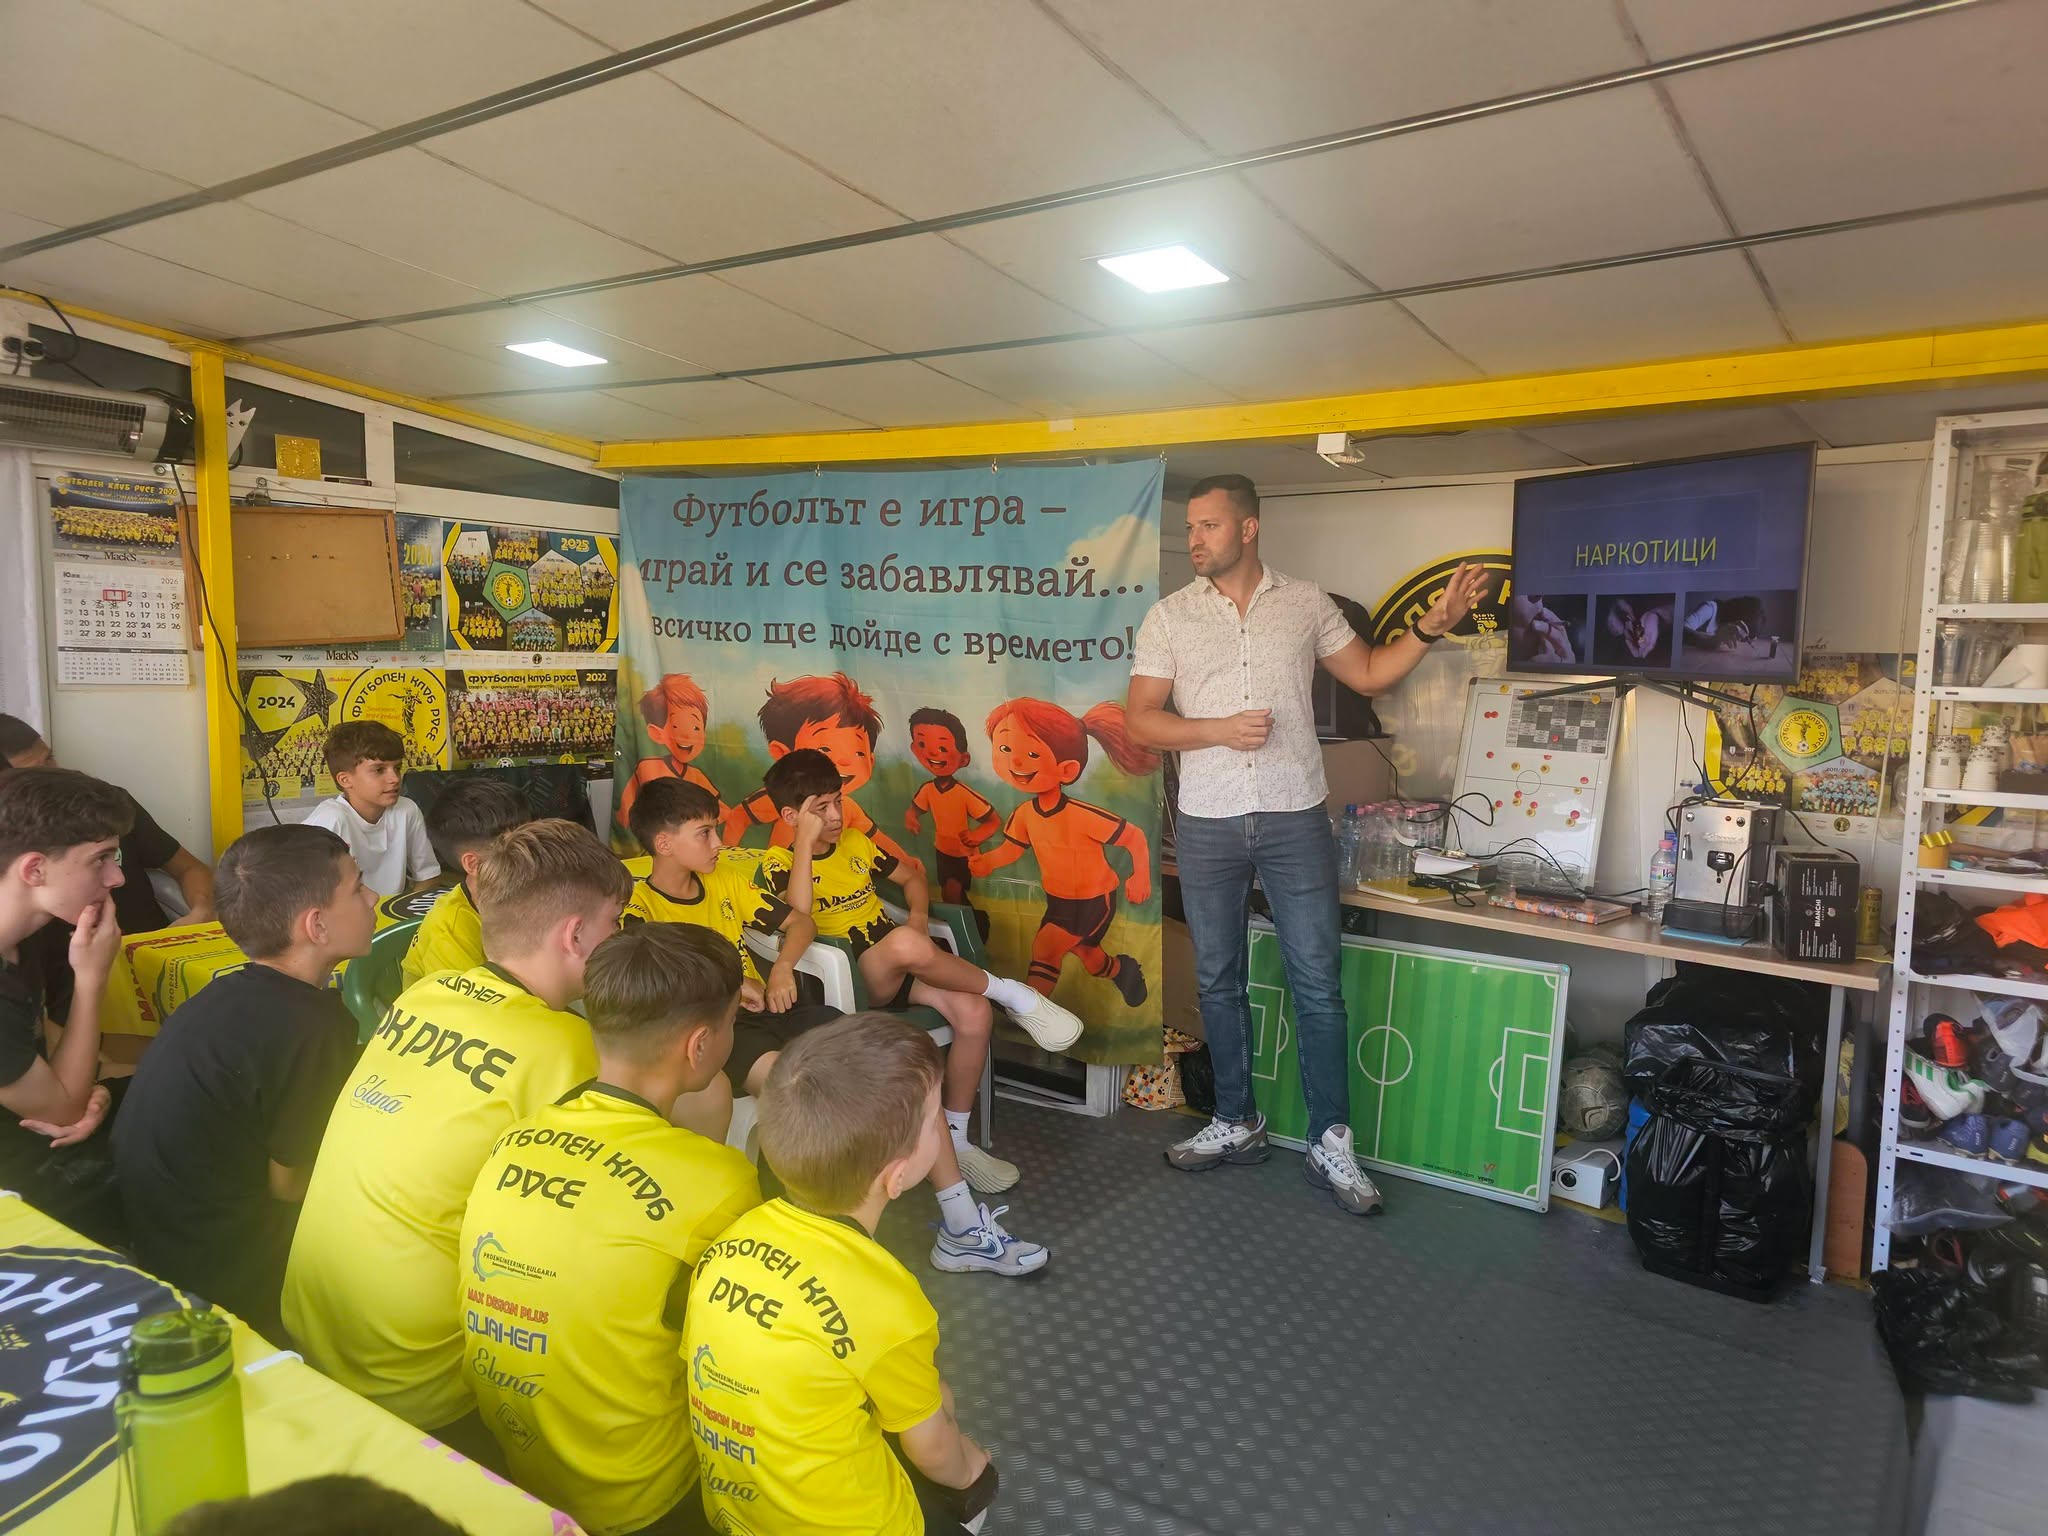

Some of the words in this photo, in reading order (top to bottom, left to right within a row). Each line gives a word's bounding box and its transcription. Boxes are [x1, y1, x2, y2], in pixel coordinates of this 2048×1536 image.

[134, 485, 155, 493] РУСЕ
[673, 490, 866, 537] Футболът
[879, 499, 902, 526] е
[919, 494, 1026, 536] игра
[560, 537, 590, 552] 2025
[1575, 536, 1717, 567] НАРКОТИЦИ
[746, 562, 770, 586] и
[783, 561, 828, 587] се
[840, 553, 1144, 599] забавлявай...
[140, 611, 151, 619] 17
[326, 650, 359, 661] Mack'S
[652, 614, 752, 643] всичко
[763, 621, 816, 647] ще
[829, 621, 922, 654] дойде
[933, 633, 952, 656] с
[964, 626, 1135, 663] времето!
[586, 672, 607, 682] 2022
[257, 695, 296, 709] 2024
[352, 672, 406, 717] ФУТБОЛЕН
[410, 675, 437, 704] КЛУБ
[426, 708, 441, 741] РУСЕ
[397, 1021, 517, 1094] РУСЕ
[353, 1074, 412, 1114] Elana
[491, 1128, 606, 1162] ТБОЛЕН
[602, 1151, 675, 1221] КЛУБ
[496, 1163, 588, 1210] РУСЕ
[483, 1252, 526, 1270] PROENGINEERING
[526, 1264, 557, 1278] BULGARIA
[467, 1287, 485, 1305] MAX
[485, 1293, 519, 1317] DESIGN
[519, 1305, 550, 1325] PLUS
[708, 1276, 784, 1330] РУСЕ
[797, 1275, 857, 1360] КЛУБ
[472, 1347, 545, 1399] Elana
[734, 1380, 760, 1395] BULGARIA
[703, 1403, 730, 1428] DESIGN
[731, 1418, 756, 1438] PLUS
